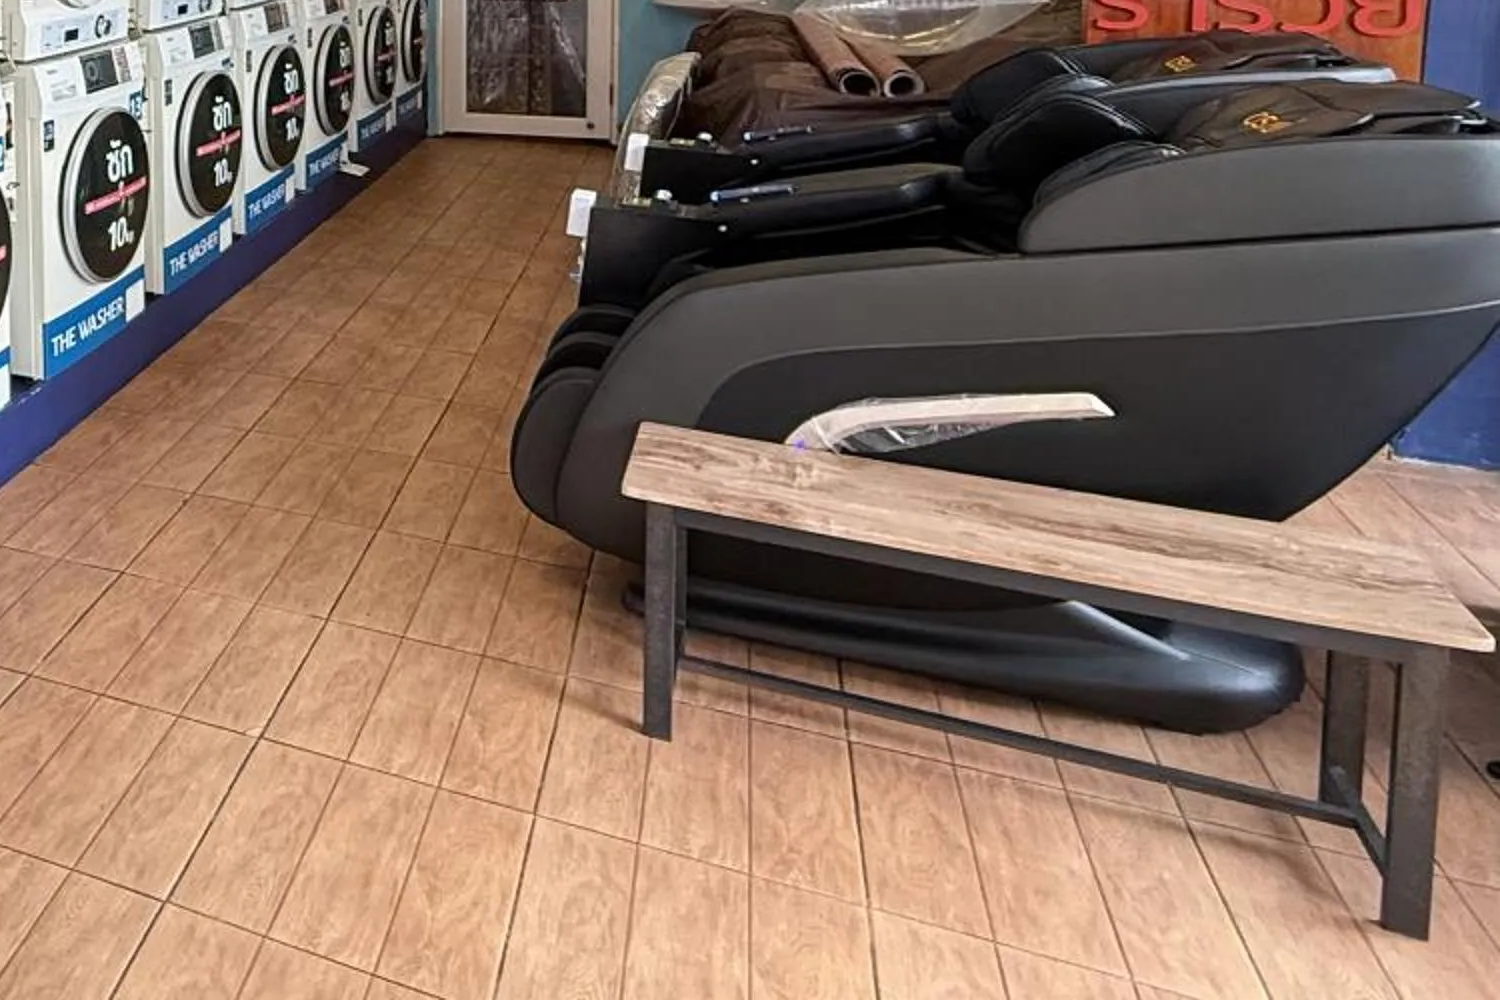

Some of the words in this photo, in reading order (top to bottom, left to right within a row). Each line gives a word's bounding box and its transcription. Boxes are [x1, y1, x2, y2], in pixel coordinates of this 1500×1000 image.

[105, 139, 134, 183] ซัก
[168, 254, 188, 276] THE
[50, 328, 78, 358] THE
[79, 294, 126, 340] WASHER
